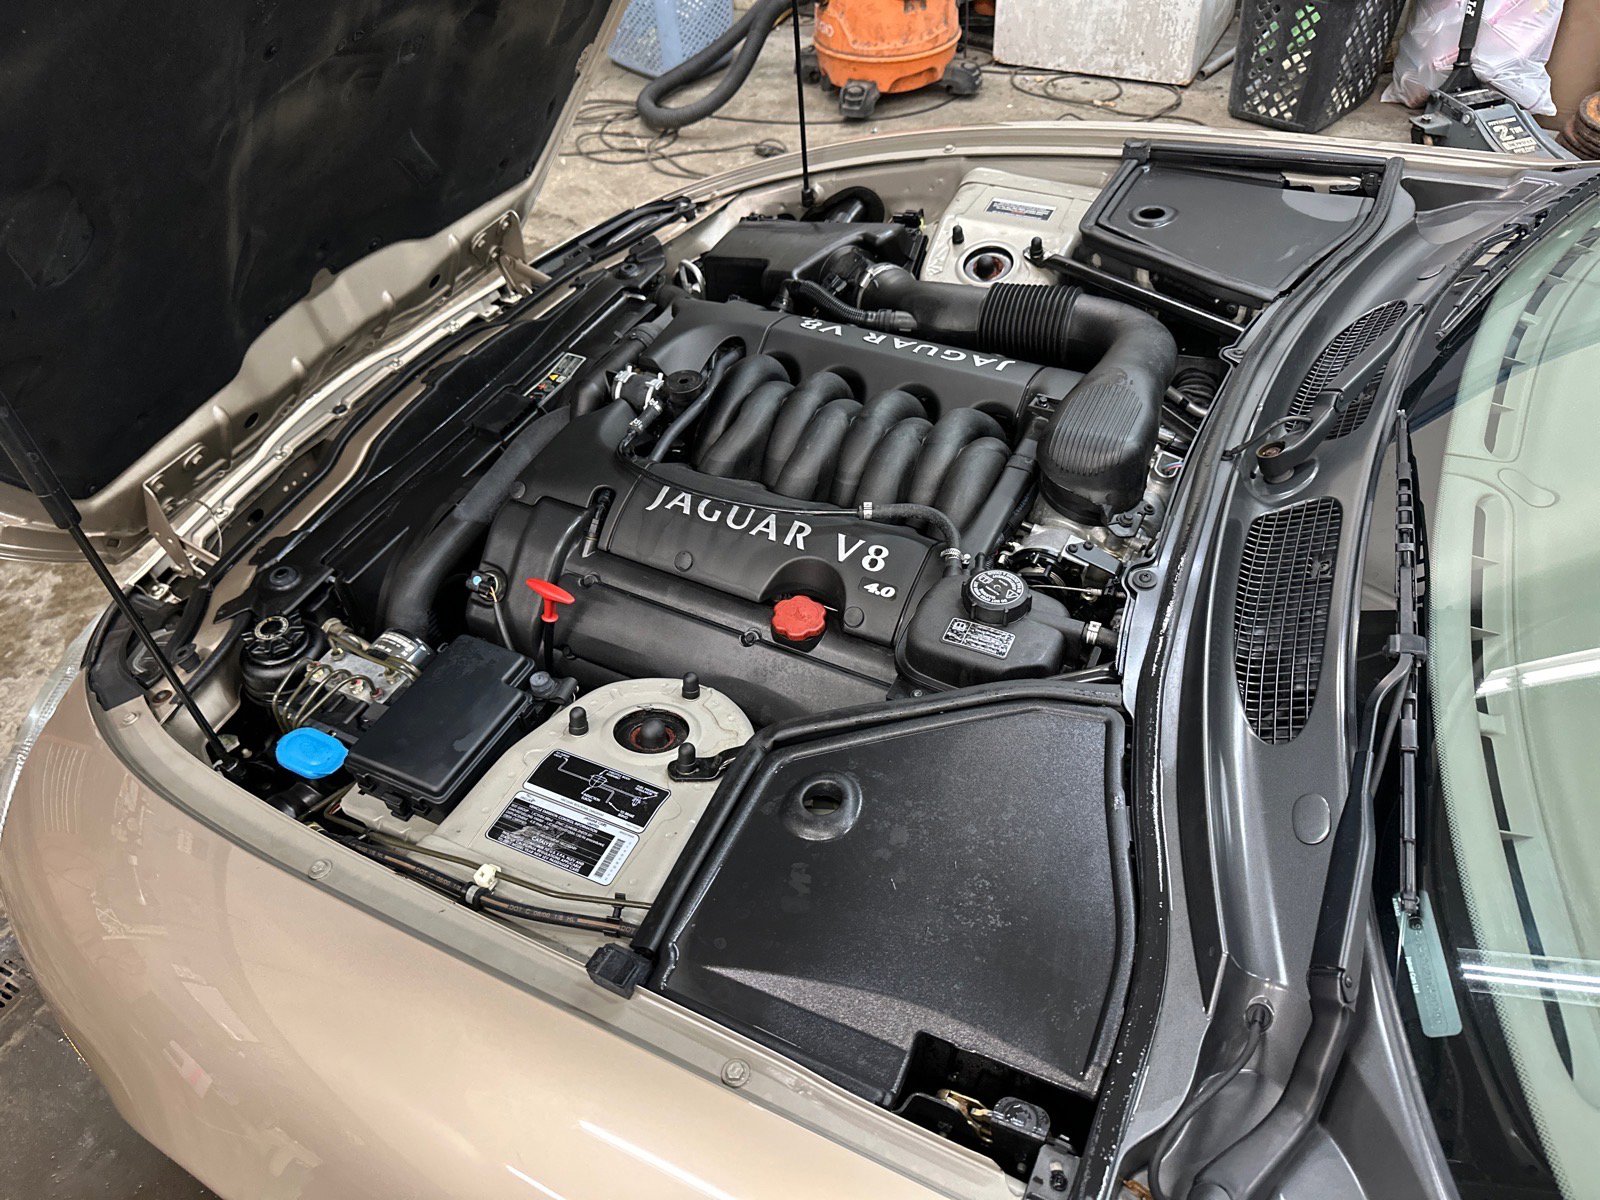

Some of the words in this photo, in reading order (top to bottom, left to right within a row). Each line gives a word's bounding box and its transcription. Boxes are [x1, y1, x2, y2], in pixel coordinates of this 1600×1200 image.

[1493, 125, 1515, 142] 2
[800, 318, 842, 336] V8
[863, 332, 1016, 371] JAGUAR
[645, 486, 812, 550] JAGUAR
[837, 532, 889, 572] V8
[863, 582, 896, 598] 4.0
